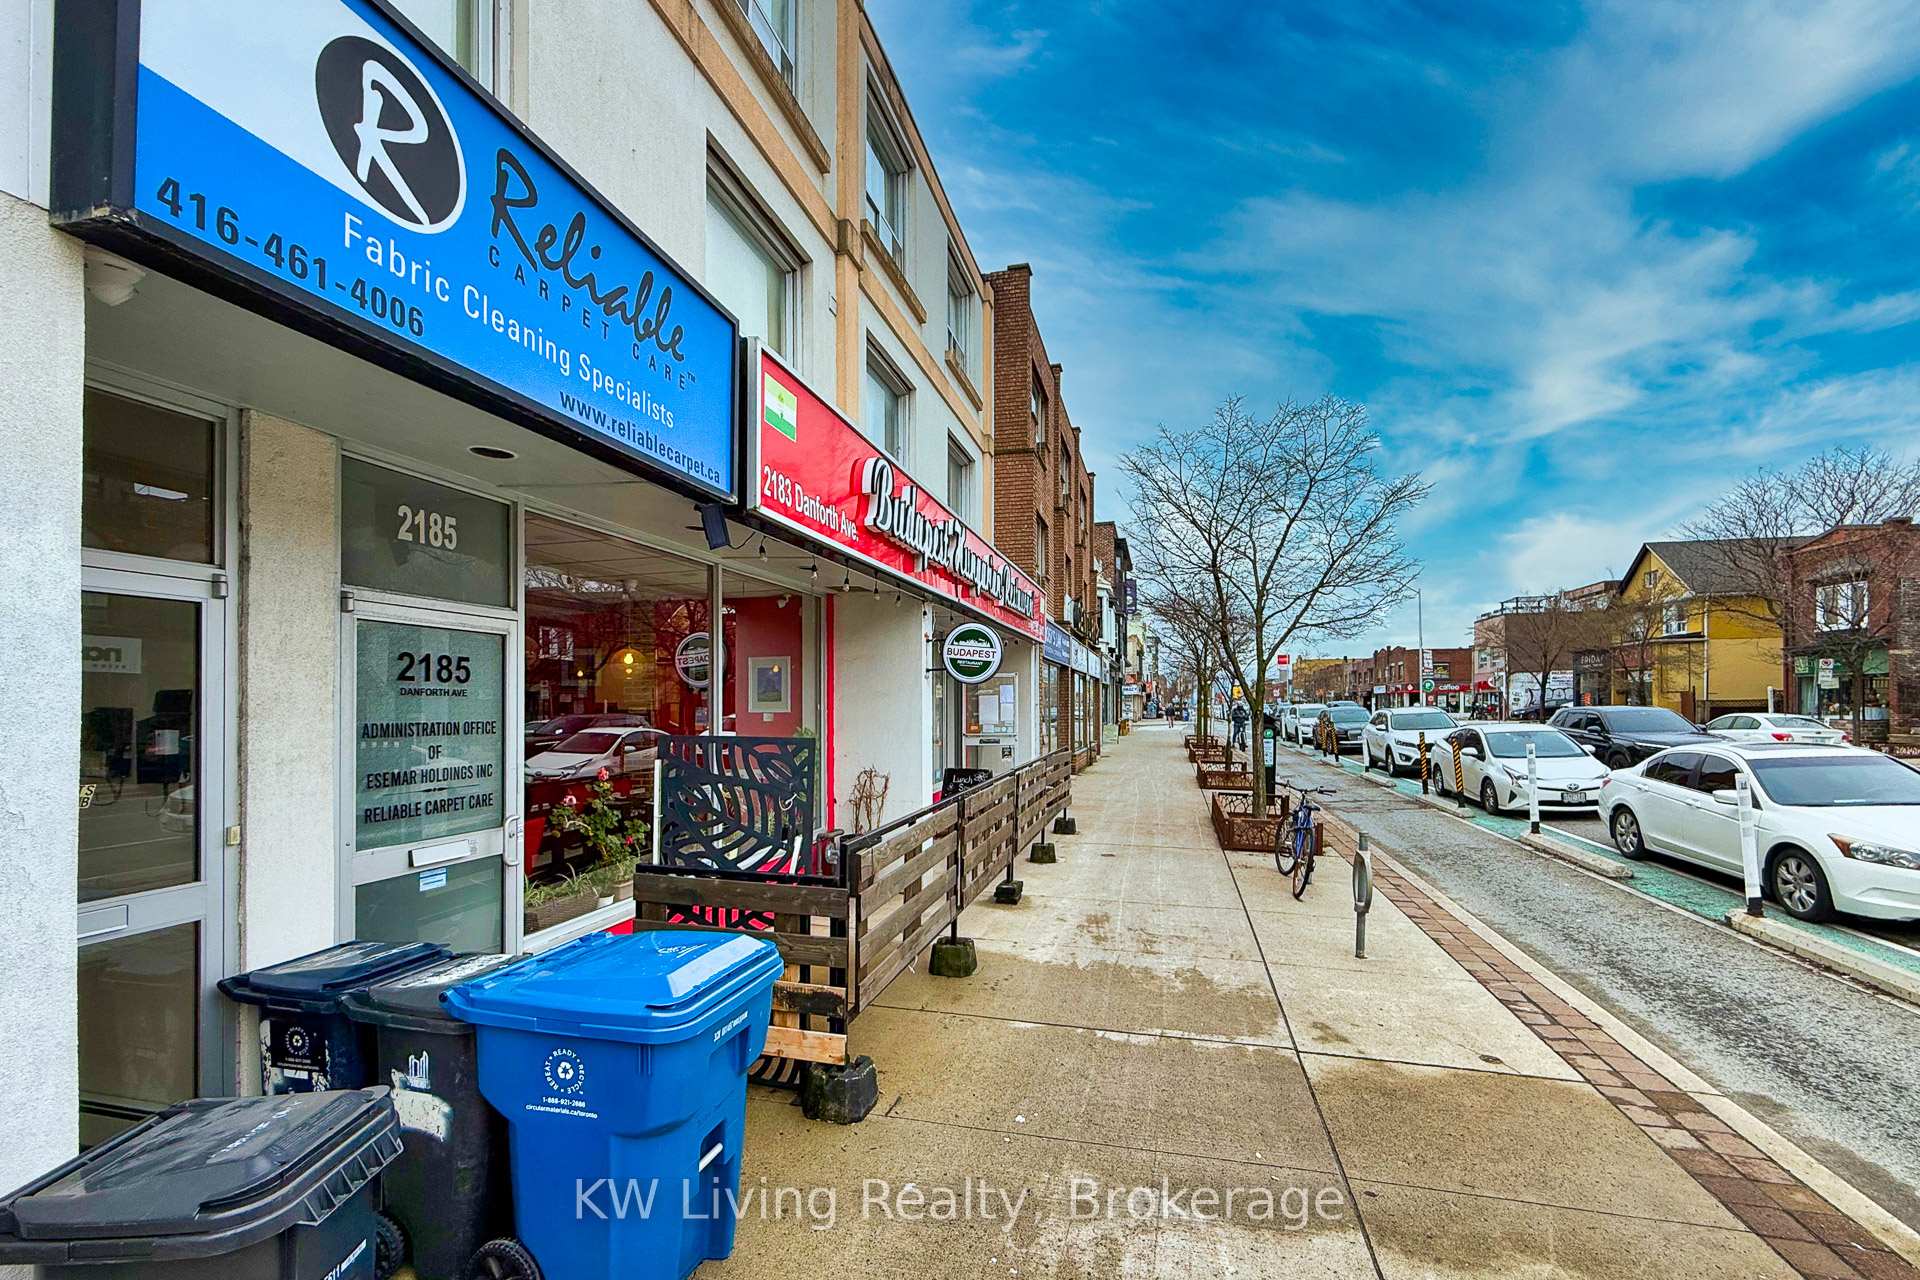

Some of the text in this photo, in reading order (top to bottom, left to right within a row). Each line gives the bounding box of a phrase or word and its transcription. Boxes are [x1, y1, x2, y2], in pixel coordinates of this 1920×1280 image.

[156, 176, 425, 338] 416-461-4006
[489, 147, 685, 363] Reliable
[488, 244, 610, 341] CARPET
[344, 211, 675, 429] Fabric Cleaning Specialists
[559, 390, 721, 484] www.reliablecarpet.ca
[763, 464, 860, 542] 2183 Danforth Ave.
[396, 504, 458, 551] 2185
[396, 651, 471, 684] 2185
[946, 647, 997, 659] BUDAPEST
[400, 687, 468, 697] DANFORTH AVE
[362, 720, 497, 739] ADMINISTRATION OFFICE
[428, 744, 443, 760] OF
[366, 763, 494, 789] ESEMAR HOLDINGS INC
[364, 792, 494, 825] RELIABLE CARPET CARE
[552, 1048, 577, 1058] READY
[543, 1060, 559, 1091] REPEAT
[566, 1064, 585, 1095] RECYCLE
